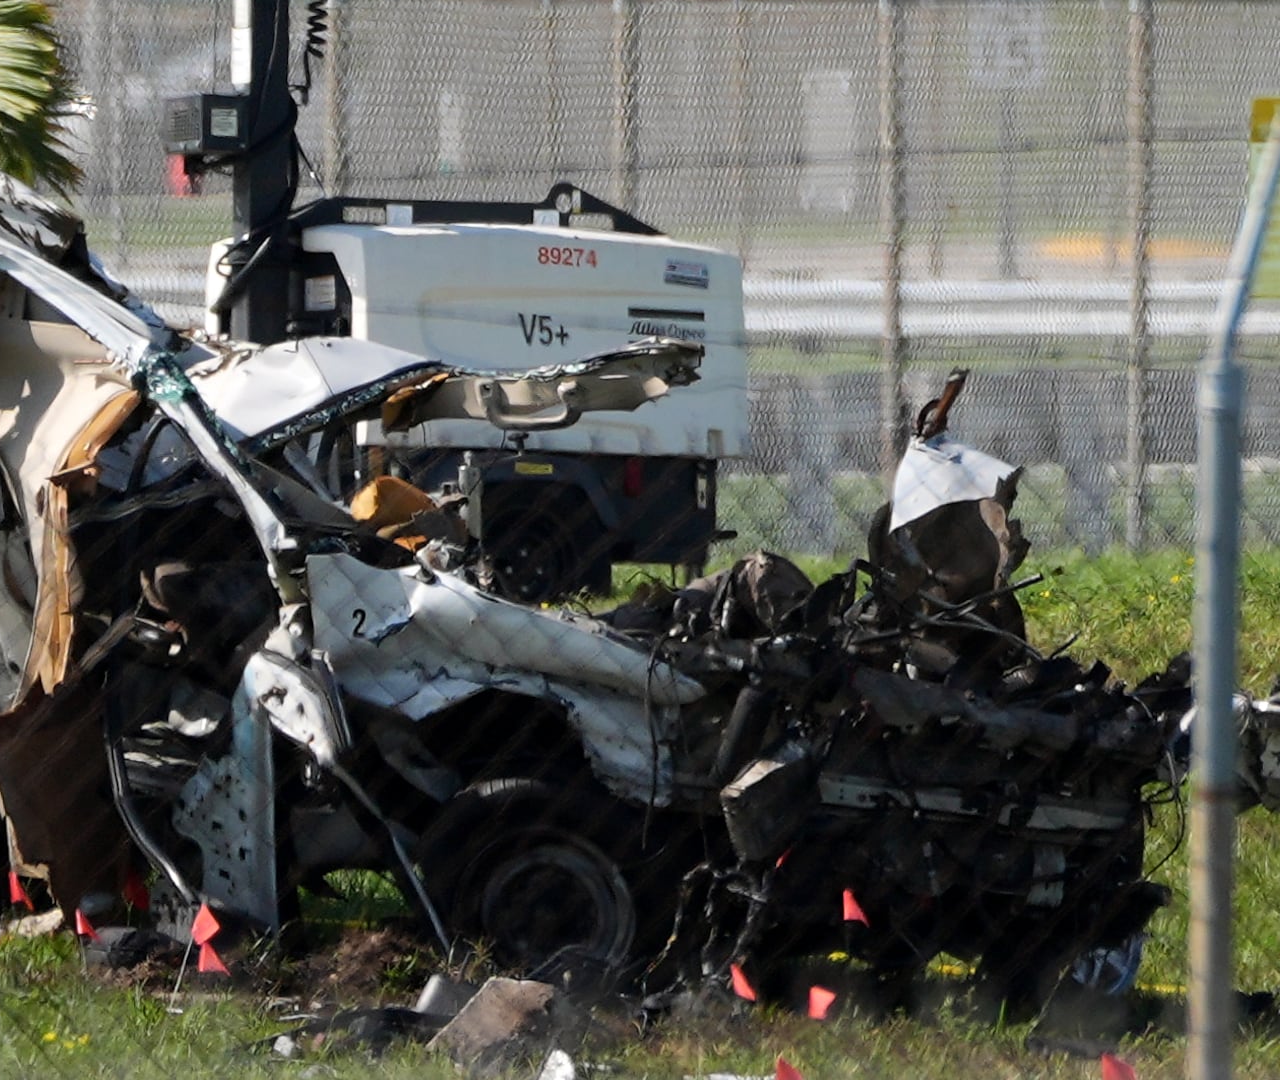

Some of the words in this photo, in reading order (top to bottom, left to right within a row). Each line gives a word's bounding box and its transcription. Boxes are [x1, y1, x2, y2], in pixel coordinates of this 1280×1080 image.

[537, 246, 599, 268] 89274
[518, 312, 570, 346] V5+
[352, 608, 366, 638] 2
